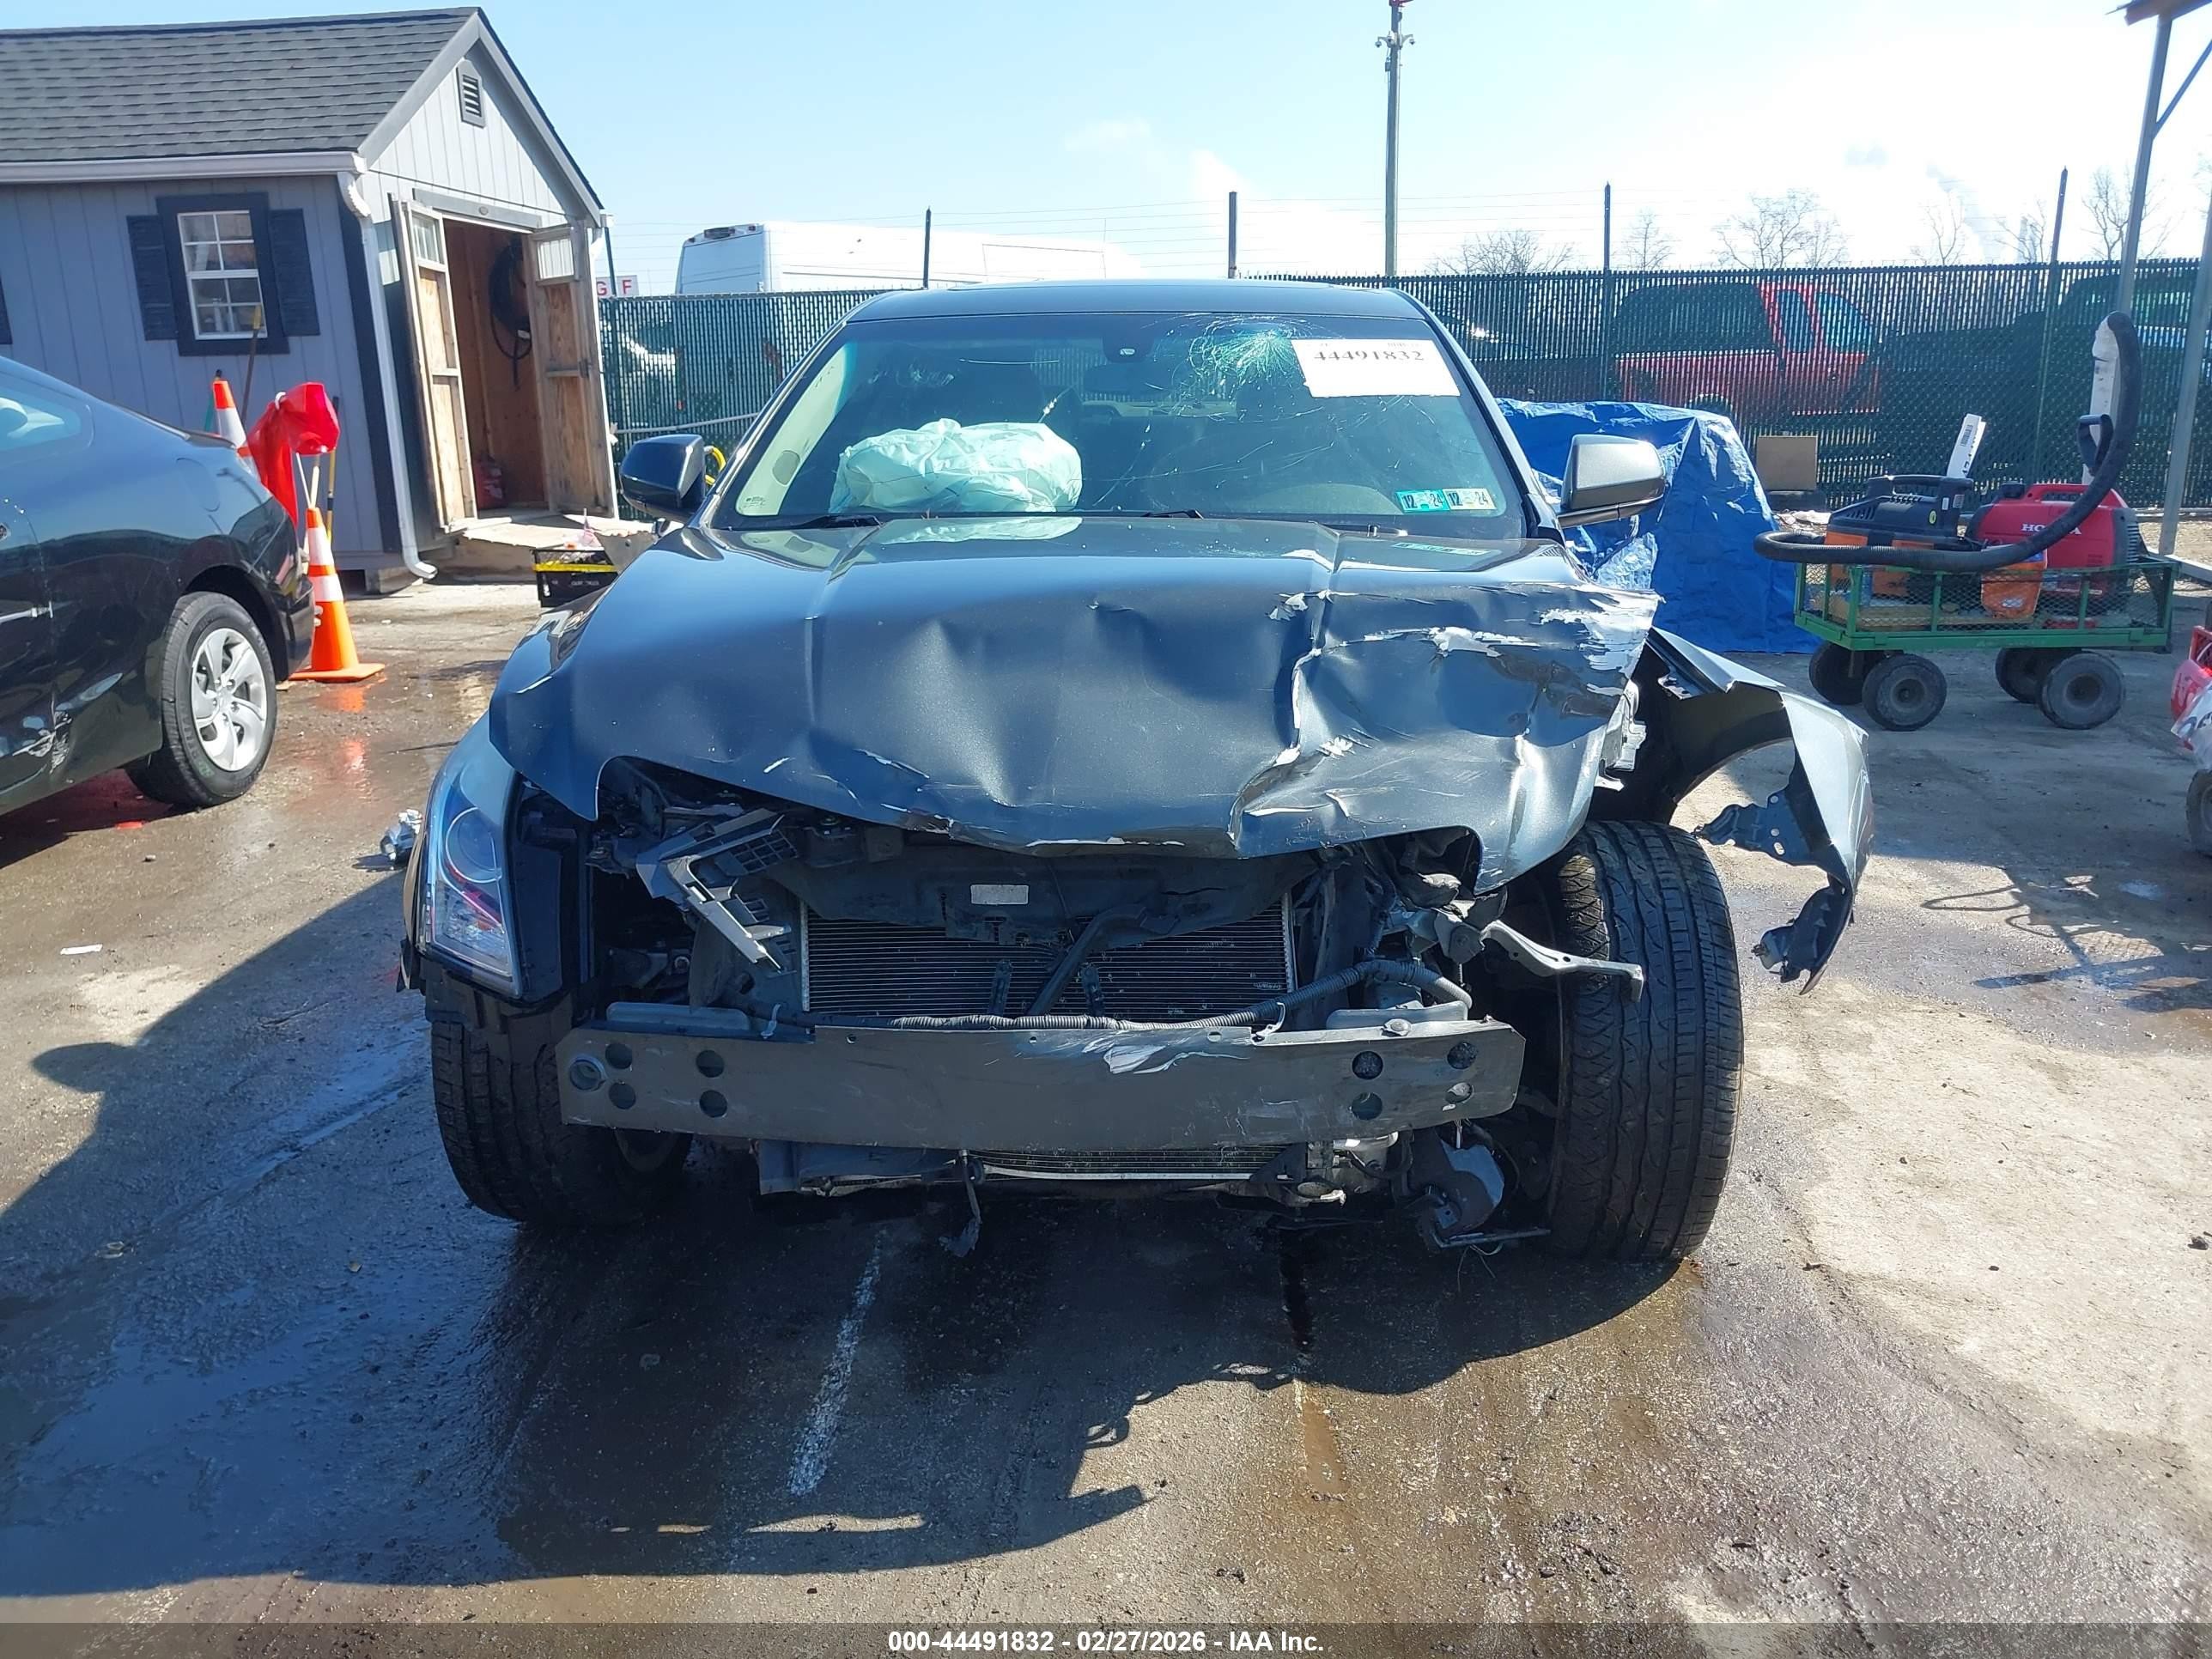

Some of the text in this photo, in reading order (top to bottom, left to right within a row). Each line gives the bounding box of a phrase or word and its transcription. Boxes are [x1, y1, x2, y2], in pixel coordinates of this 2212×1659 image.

[1314, 350, 1425, 362] 44491832
[1402, 493, 1443, 509] 12 24
[1448, 491, 1489, 507] 12 24
[2021, 523, 2082, 535] HOA
